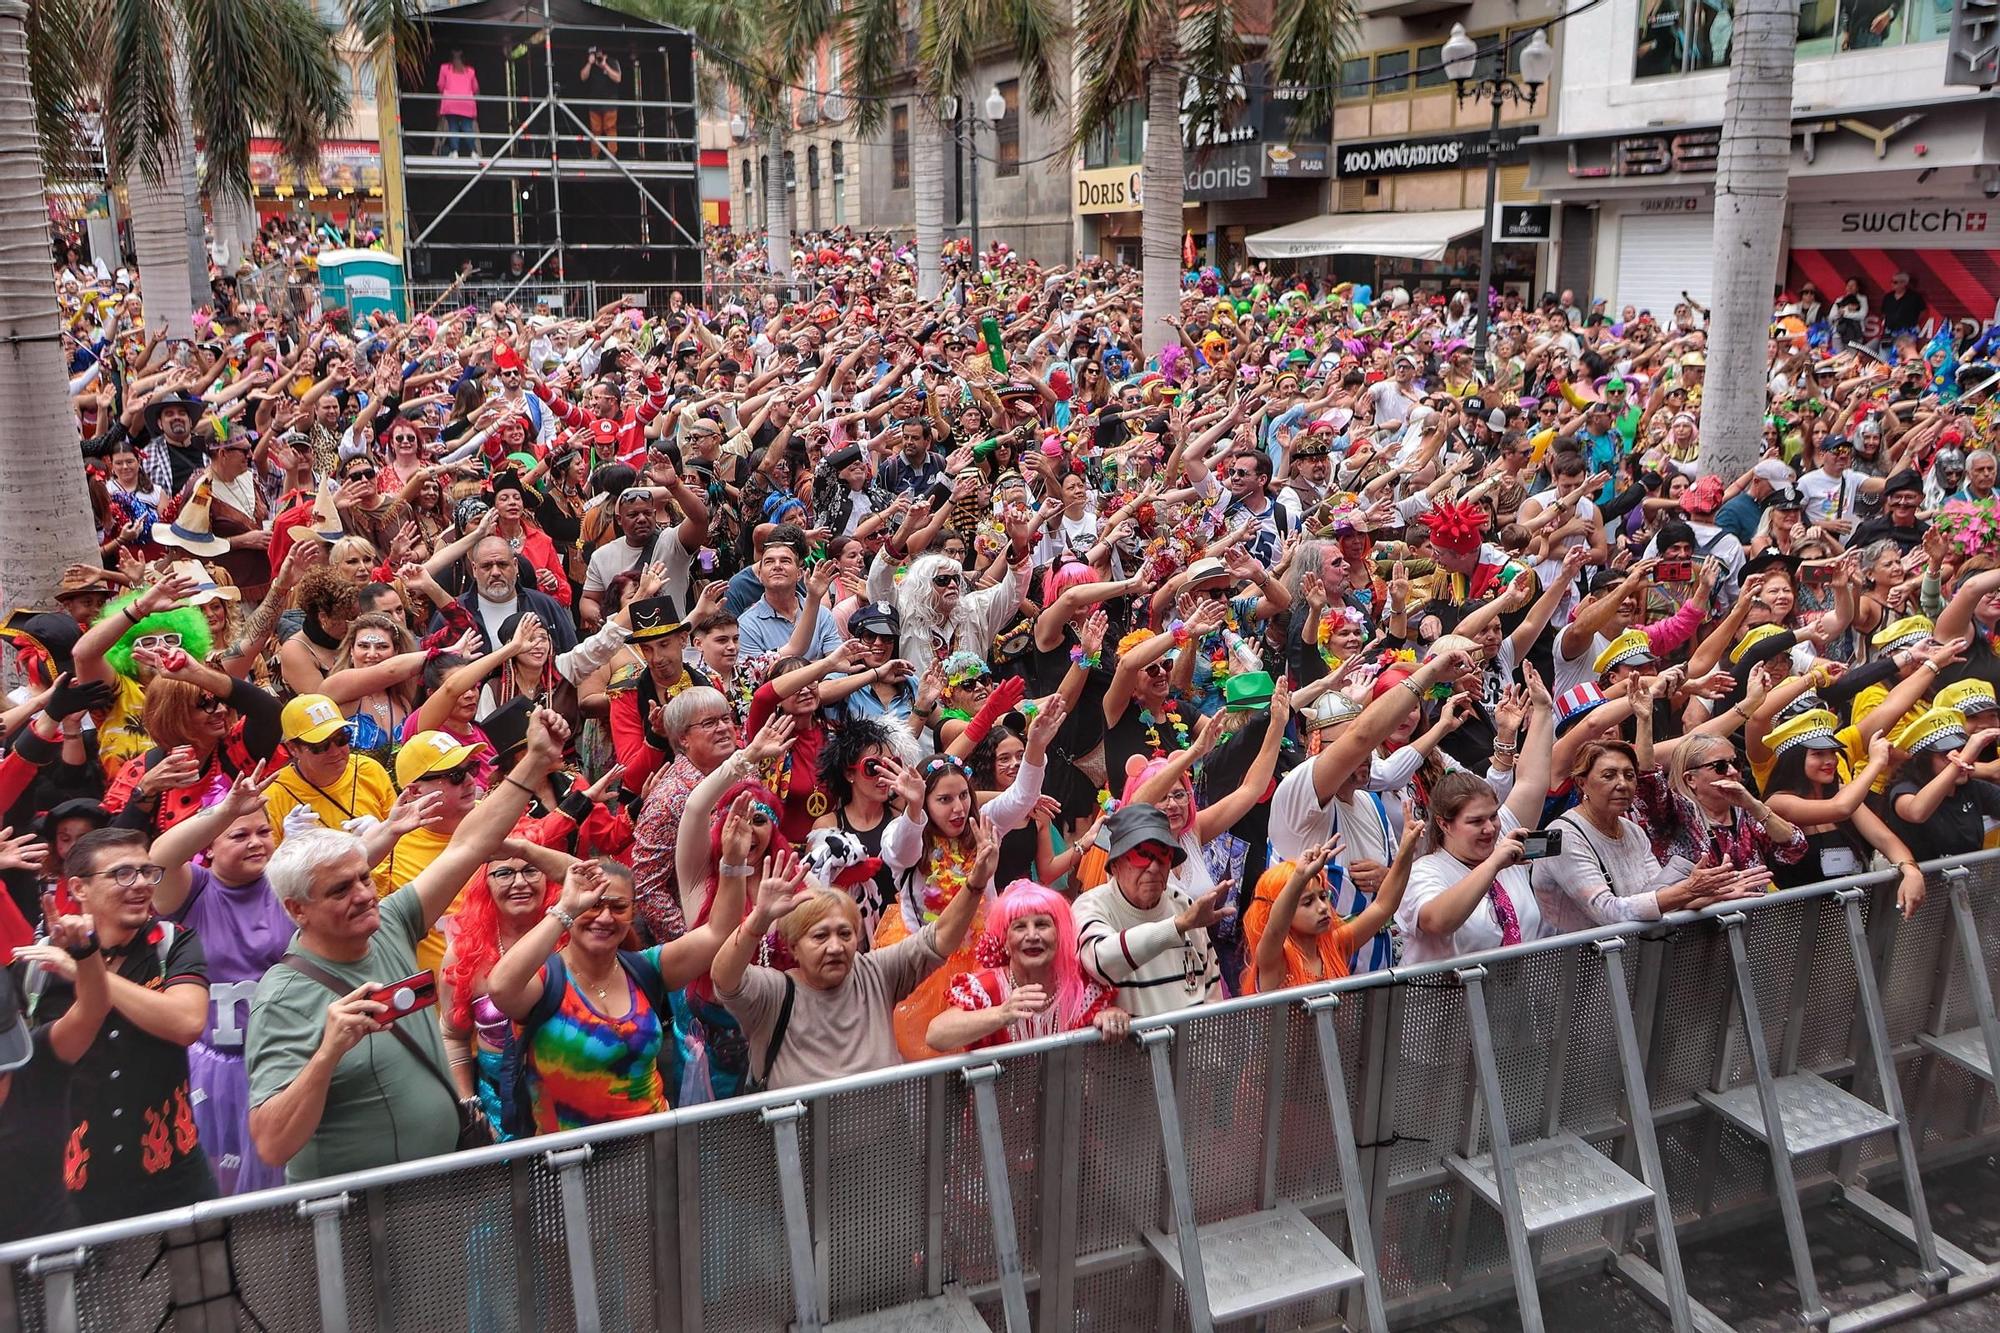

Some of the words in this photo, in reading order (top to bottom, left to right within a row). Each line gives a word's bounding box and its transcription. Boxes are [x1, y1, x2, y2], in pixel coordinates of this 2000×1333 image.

[1344, 151, 1372, 172] 100
[1371, 142, 1459, 170] MONTADITOS
[1568, 113, 1926, 178] LIBETY
[1300, 160, 1323, 170] PLAZA
[1841, 208, 1962, 232] swatch
[1468, 399, 1482, 408] FBI
